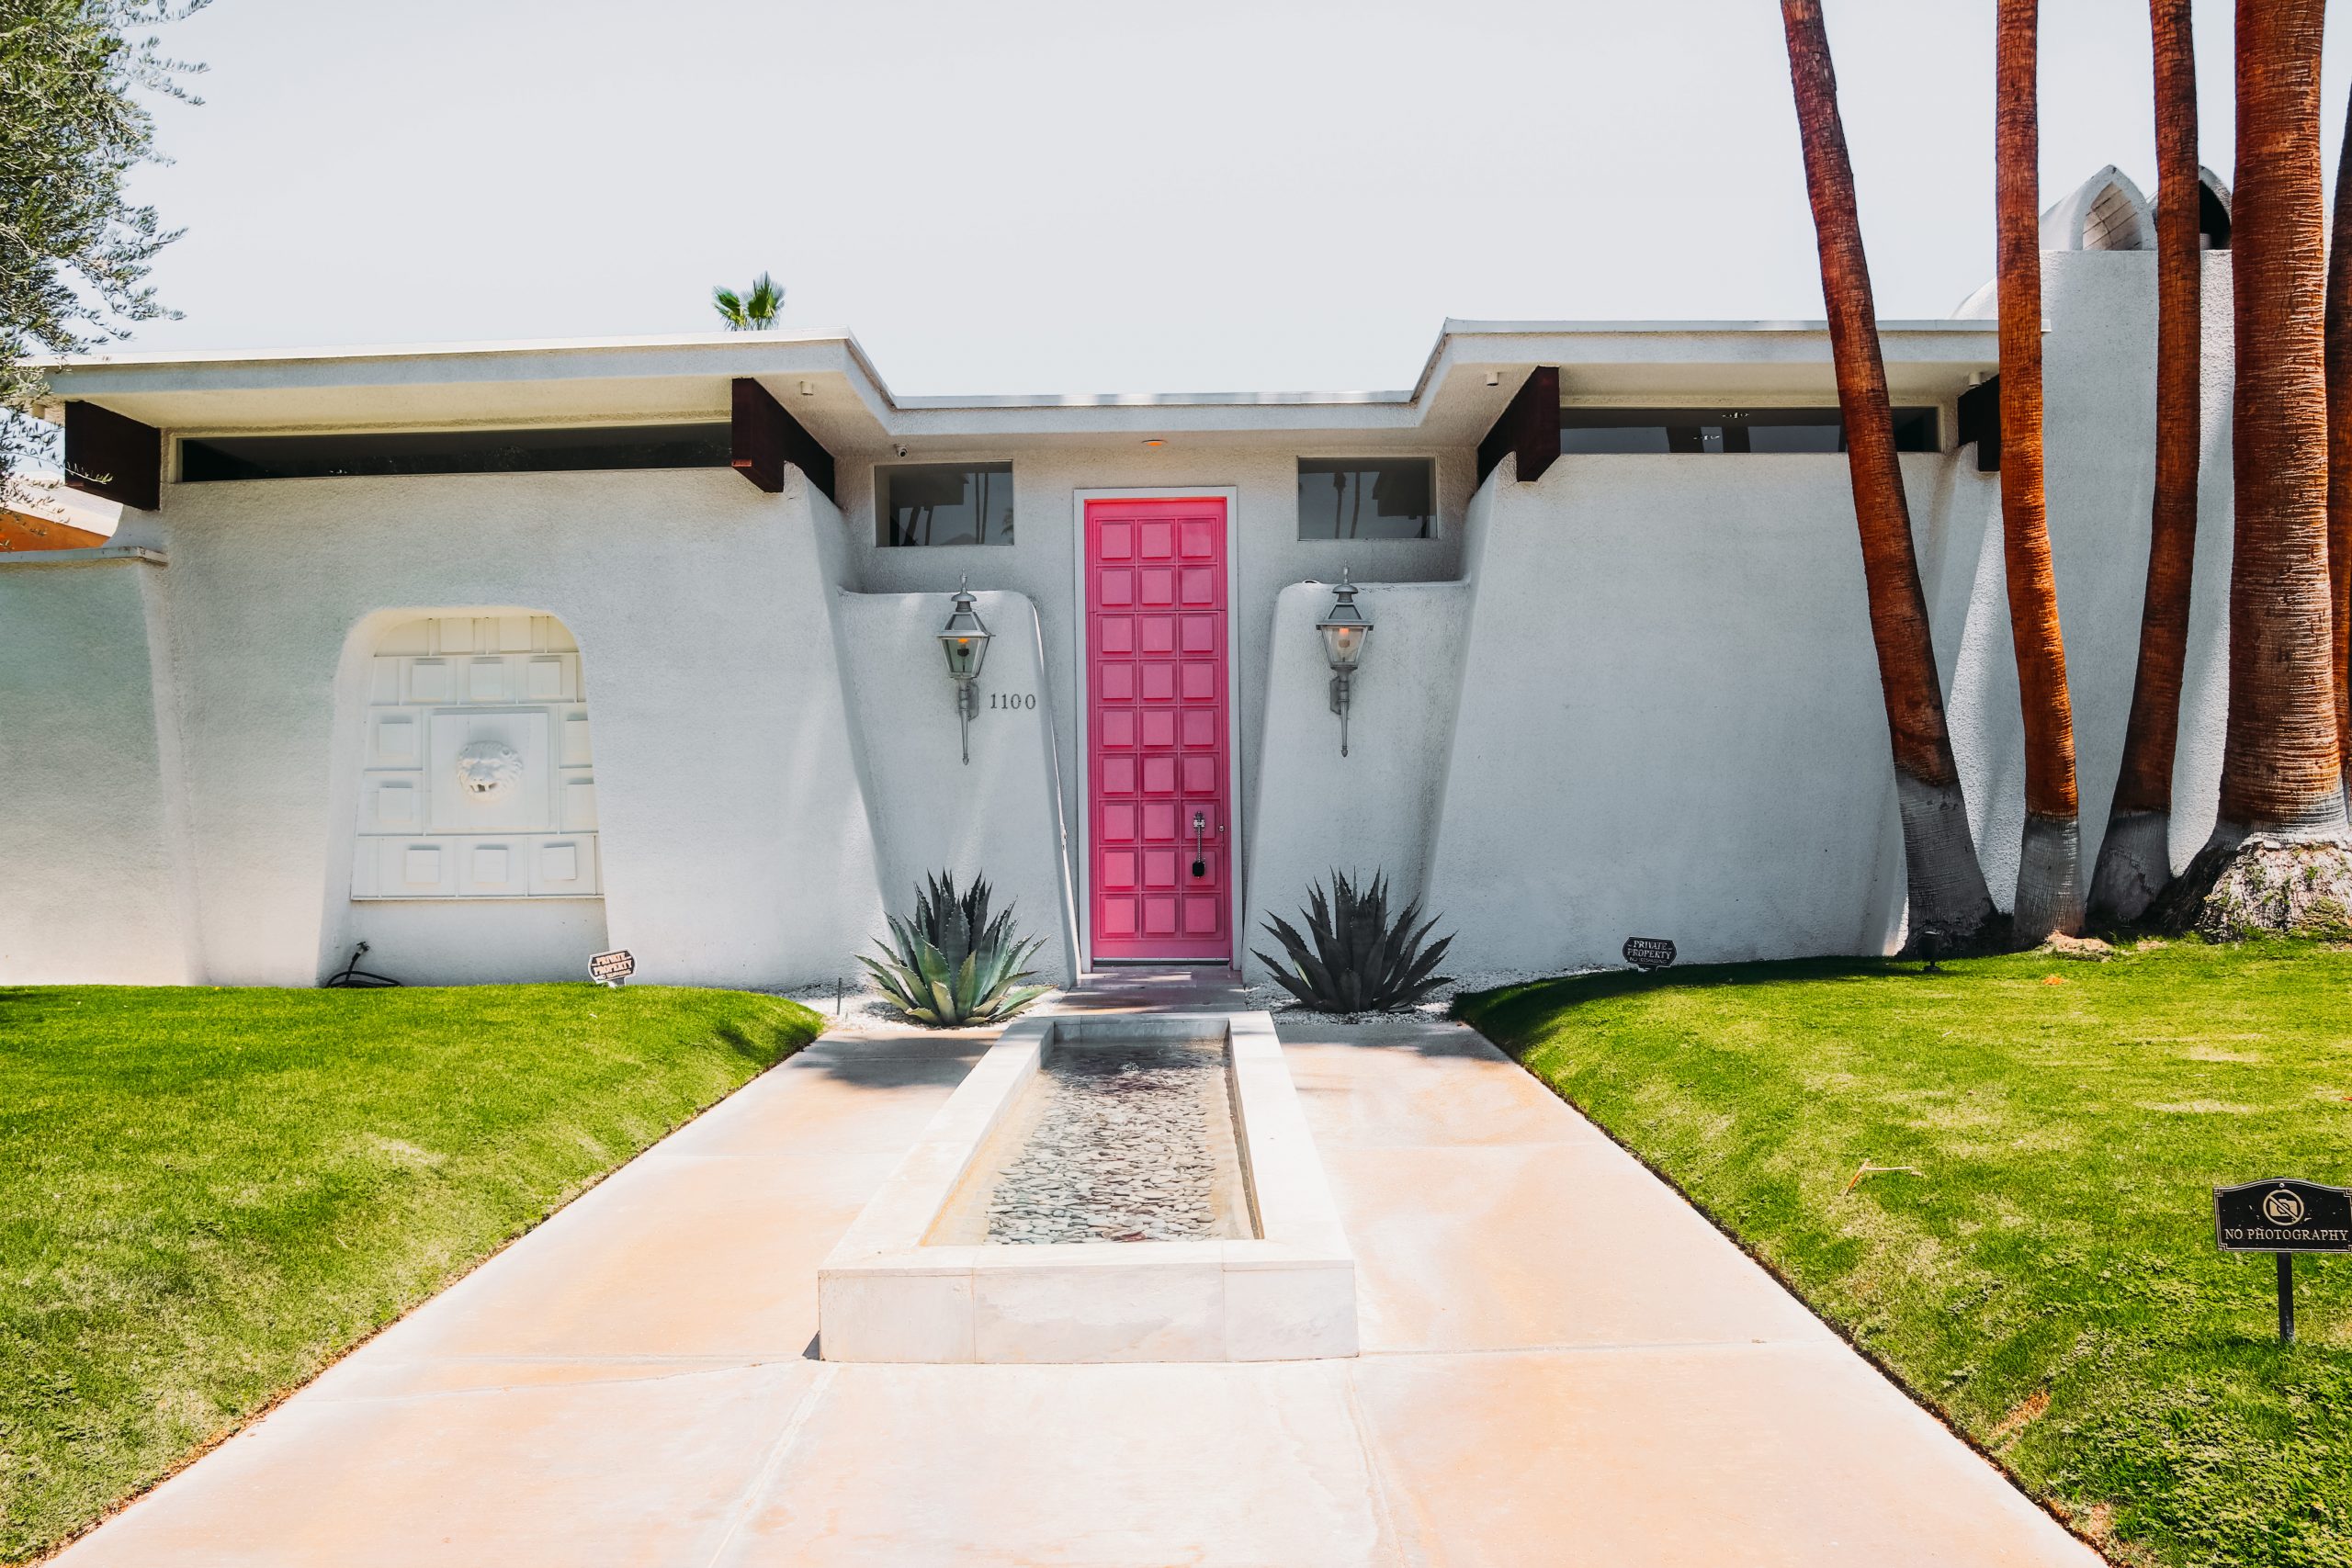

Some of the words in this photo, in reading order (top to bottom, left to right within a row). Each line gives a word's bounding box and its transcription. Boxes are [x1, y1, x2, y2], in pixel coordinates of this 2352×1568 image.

[990, 694, 1036, 709] 1100
[1633, 940, 1668, 951] PRIVATE
[595, 952, 626, 965] PRIVATE
[1627, 948, 1672, 960] PROPERTY
[593, 960, 632, 976] PROPERTY
[2224, 1228, 2244, 1240] NO
[2246, 1228, 2348, 1241] PHOTOGRAPHY
